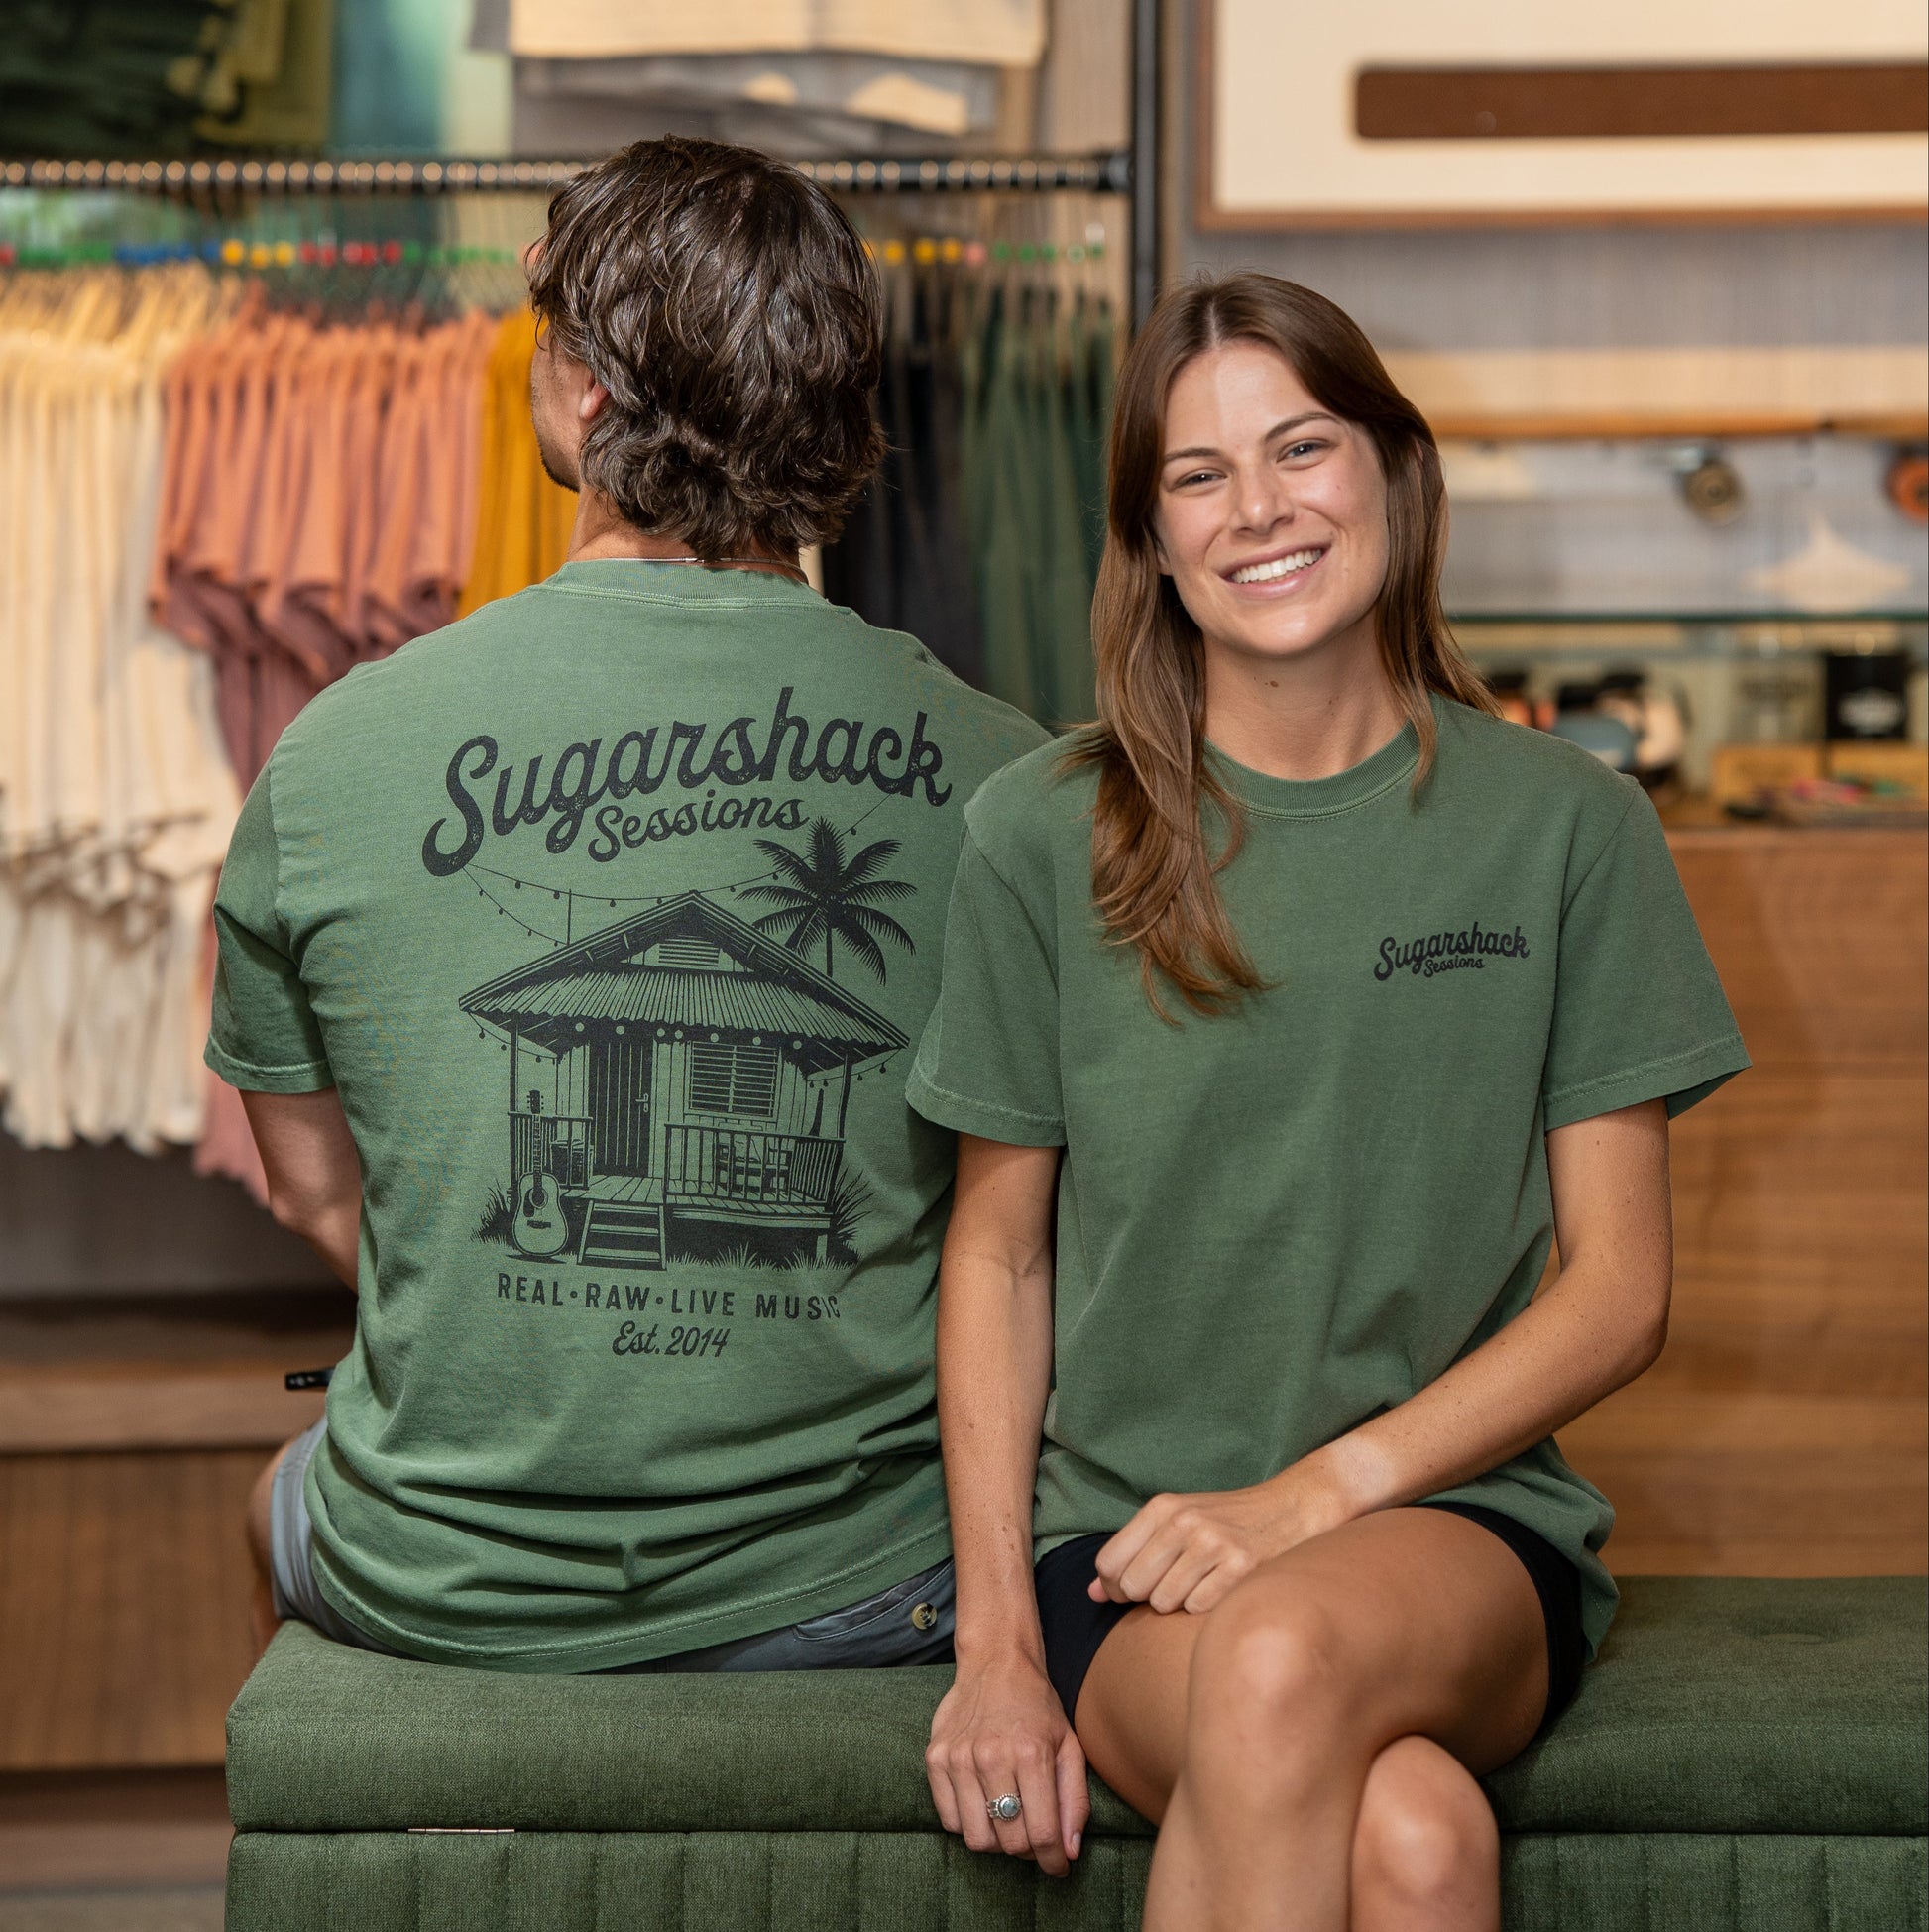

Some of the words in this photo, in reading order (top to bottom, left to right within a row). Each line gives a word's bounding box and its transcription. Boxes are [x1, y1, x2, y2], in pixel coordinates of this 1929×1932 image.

[421, 686, 953, 877] Sugarshack
[588, 789, 810, 863] Sessions
[1374, 921, 1530, 981] Sugarshack
[1423, 955, 1485, 978] Sessions
[755, 1294, 841, 1320] MUSIC
[612, 1320, 661, 1356] Est.
[665, 1326, 731, 1358] 2014
